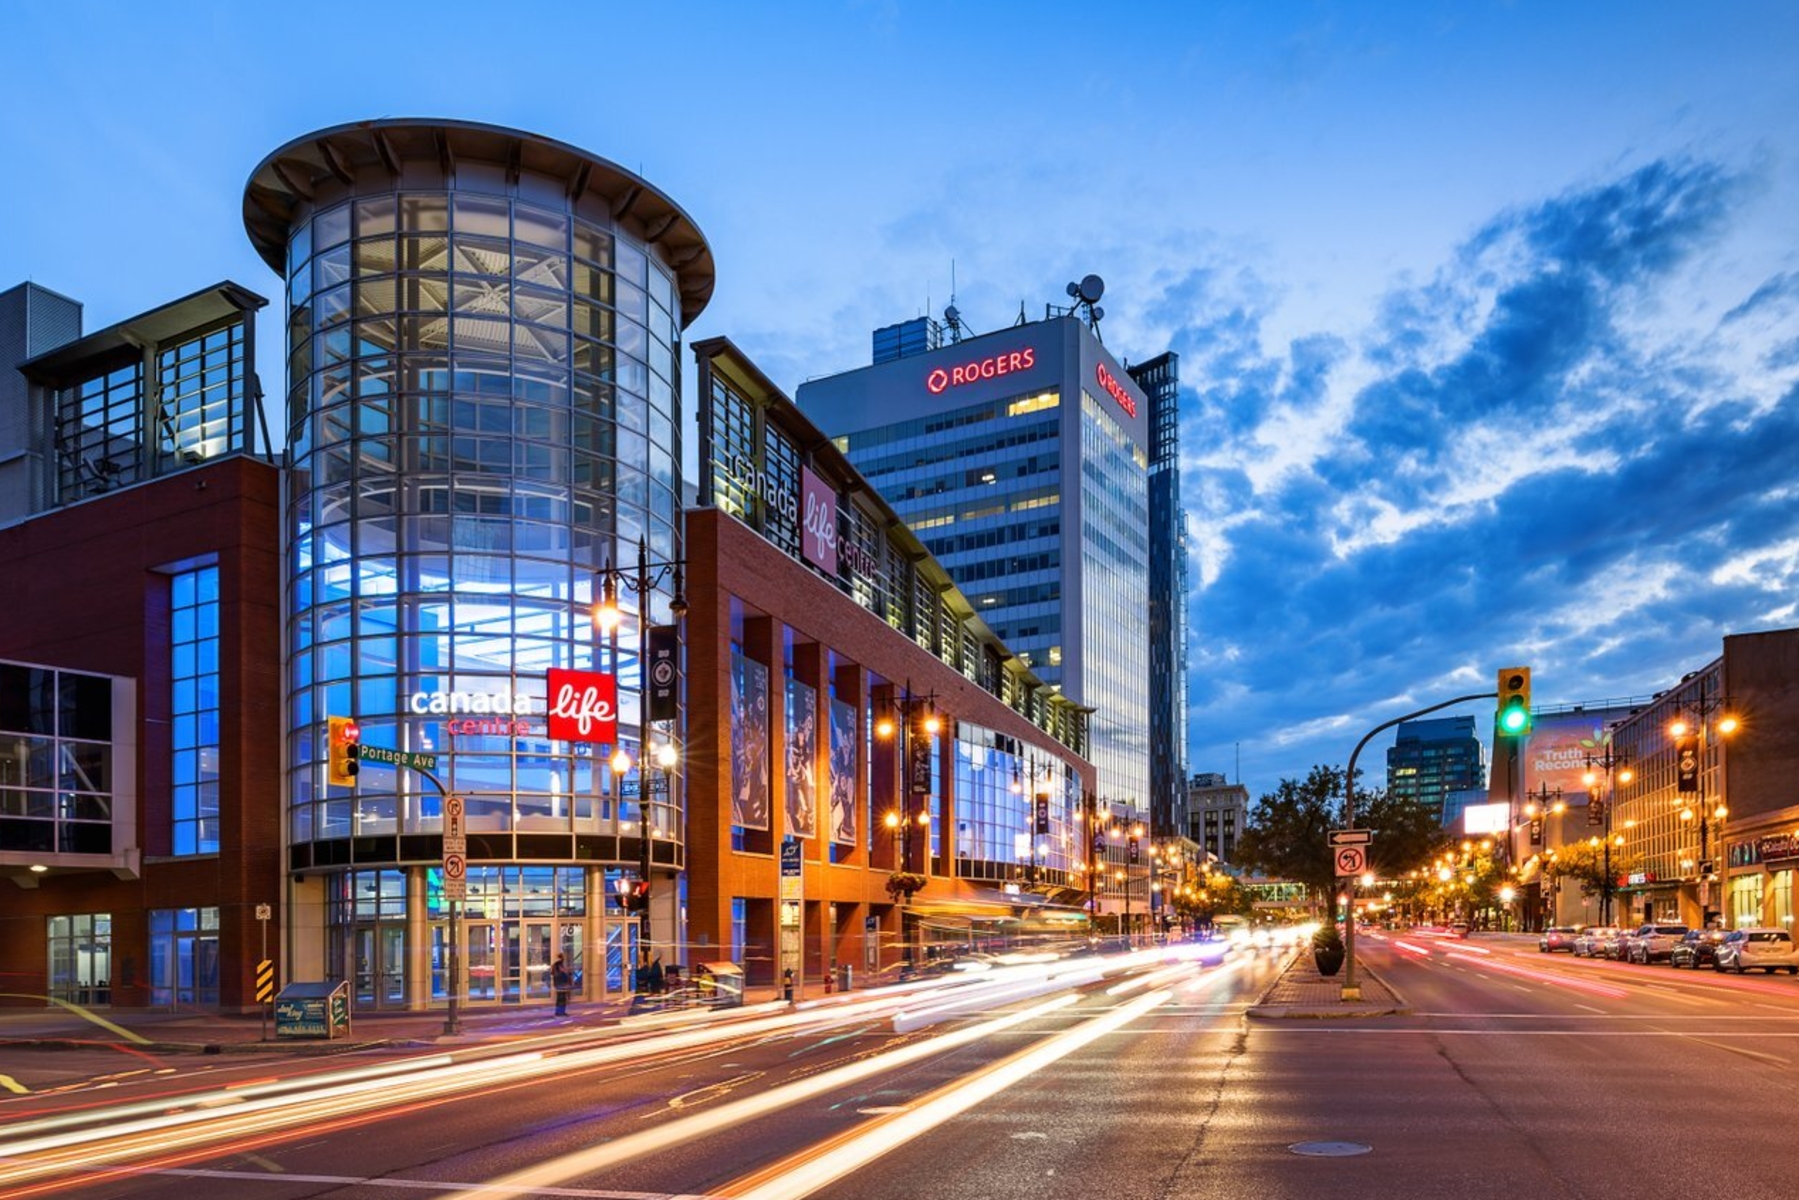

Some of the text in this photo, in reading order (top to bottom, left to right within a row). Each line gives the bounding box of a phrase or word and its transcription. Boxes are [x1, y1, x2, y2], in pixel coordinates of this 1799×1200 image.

[952, 348, 1035, 386] ROGERS
[1106, 373, 1136, 418] ROGERS
[734, 455, 878, 581] canada life centre
[411, 683, 616, 735] canada life
[448, 716, 530, 738] centre
[361, 745, 434, 768] Portage Ave
[1543, 747, 1583, 761] Truth
